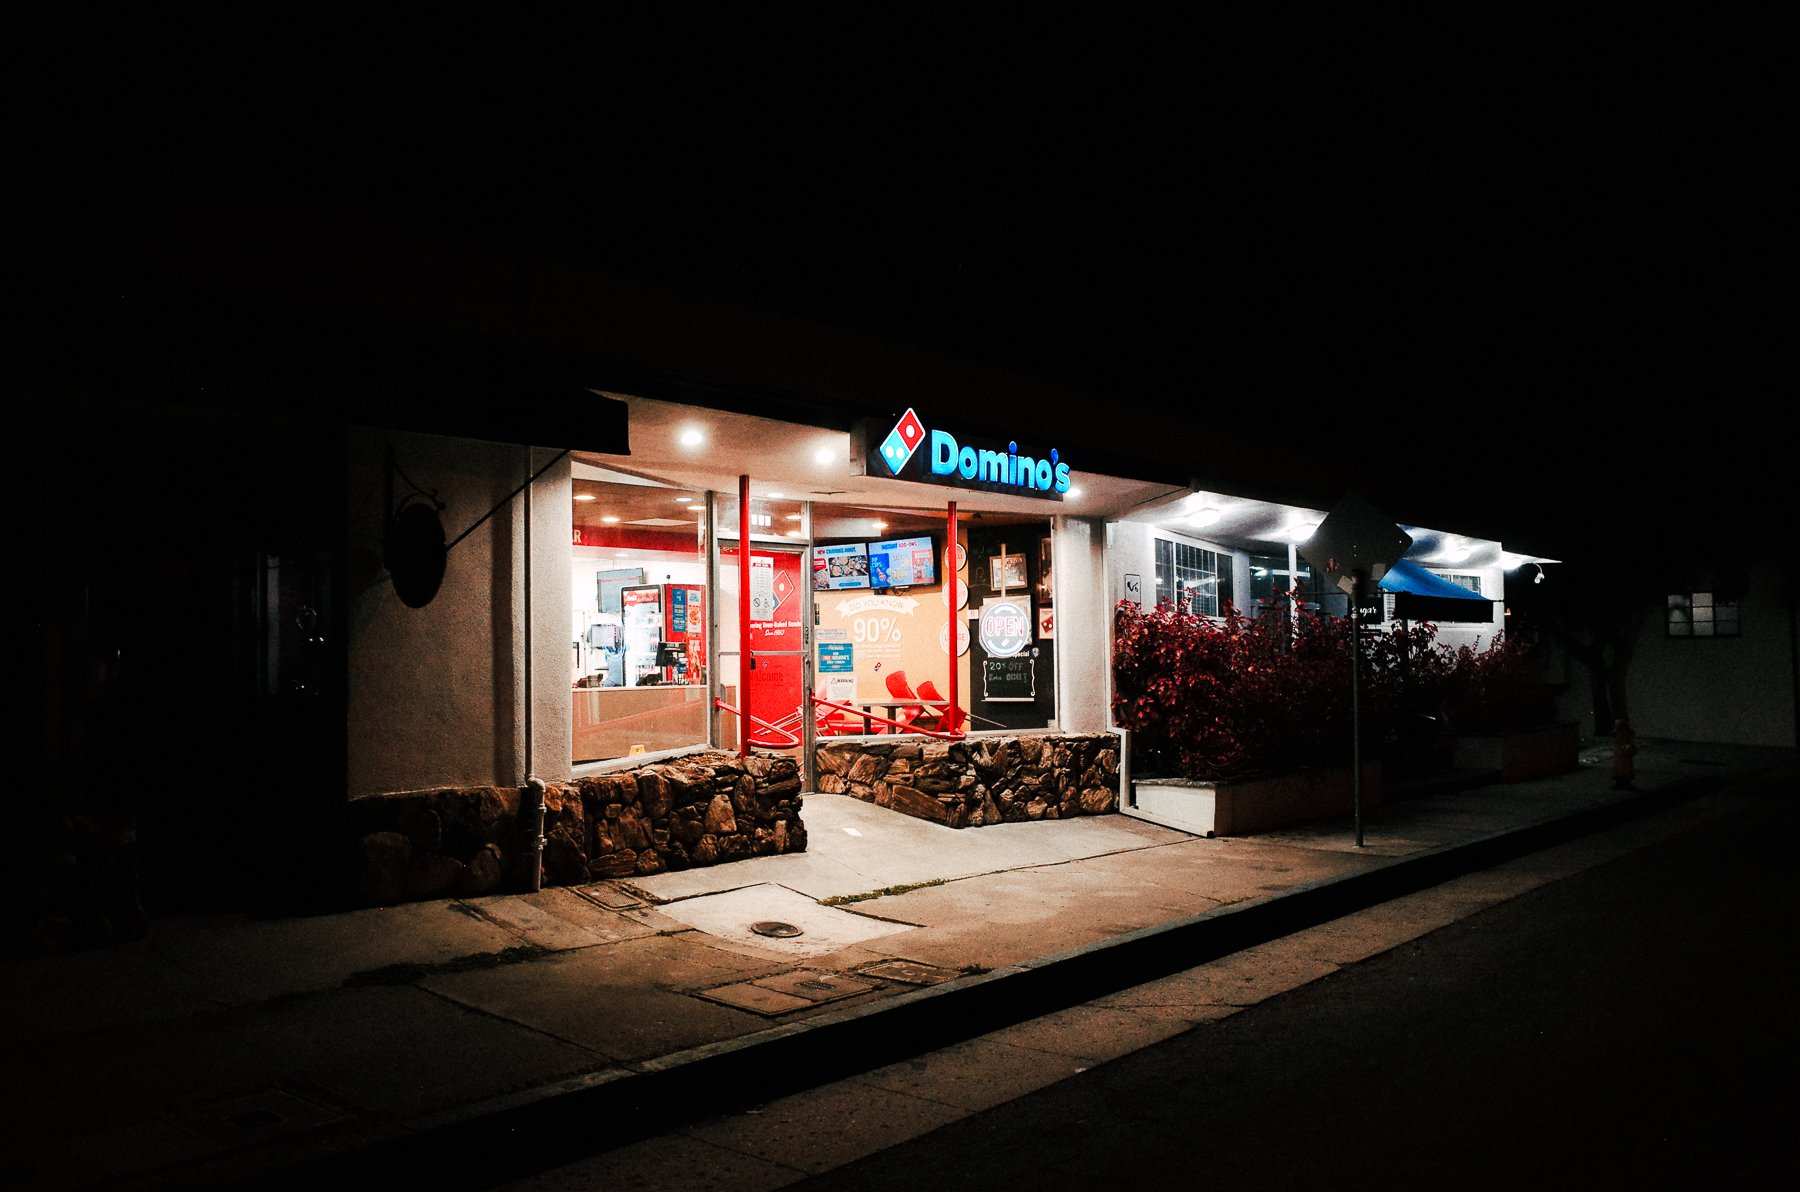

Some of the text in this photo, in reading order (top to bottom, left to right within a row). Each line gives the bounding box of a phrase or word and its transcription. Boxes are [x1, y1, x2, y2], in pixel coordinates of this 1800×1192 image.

[931, 429, 1071, 493] Domino's
[1359, 606, 1377, 617] ugar
[854, 617, 902, 642] 90%
[985, 615, 1024, 637] OPEN
